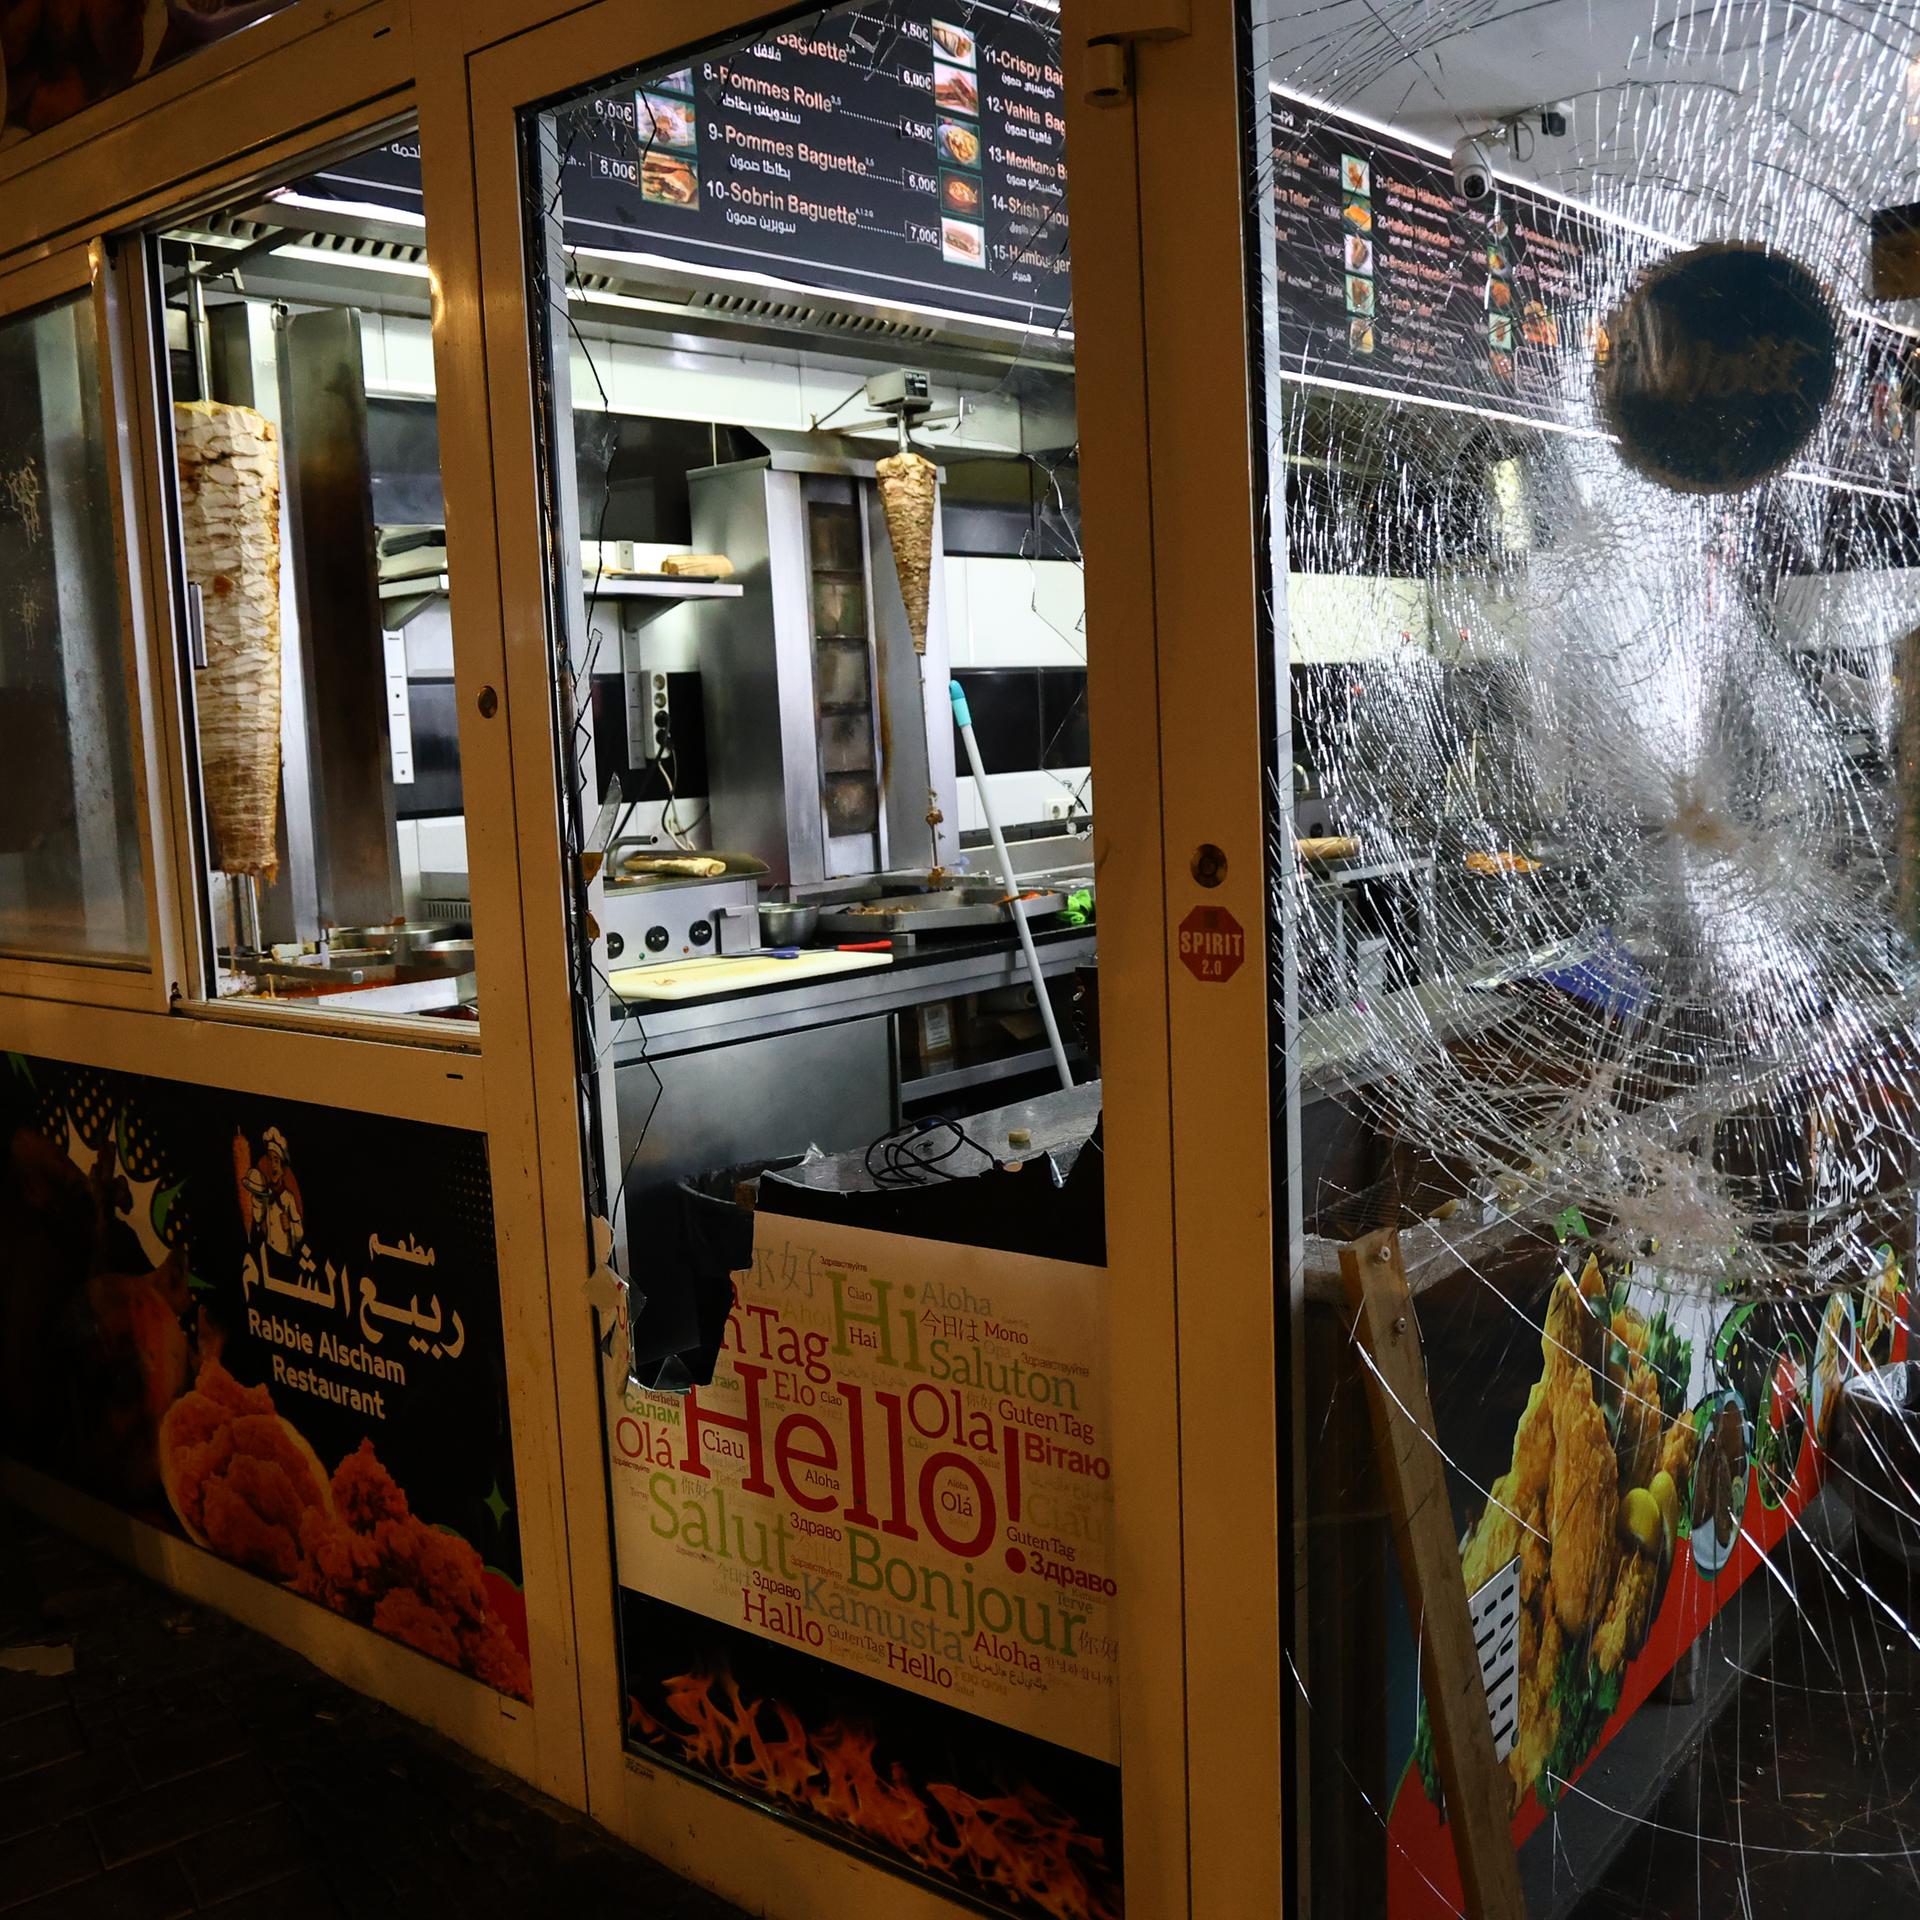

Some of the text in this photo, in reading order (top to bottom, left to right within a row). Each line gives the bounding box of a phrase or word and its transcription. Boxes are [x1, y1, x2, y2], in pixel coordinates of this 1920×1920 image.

[901, 22, 929, 42] 4,50€
[903, 70, 932, 91] 6,00€
[794, 86, 832, 113] Rolle
[905, 120, 933, 141] 4,50€
[600, 158, 636, 180] 8,00€
[798, 143, 867, 176] Baguette
[909, 175, 936, 193] 6,00€
[788, 194, 857, 226] Baguette
[911, 226, 938, 245] 7,00€
[1181, 931, 1242, 956] SPIRIT
[1202, 959, 1222, 976] 2.0
[369, 1232, 435, 1266] مطعم
[242, 1241, 465, 1359] ربيع الشام
[847, 1286, 872, 1302] Ciao
[920, 1281, 993, 1317] Aloha
[825, 1270, 927, 1374] Hi
[848, 1326, 878, 1349] Hai
[920, 1308, 980, 1342] 今日は
[984, 1320, 1029, 1345] Mono
[248, 1308, 406, 1386] Rabbie Alscham
[272, 1354, 386, 1420] Restaurant
[774, 1369, 815, 1406] Elo
[929, 1339, 1080, 1411] Saluton
[623, 1392, 680, 1426] Салам
[820, 1391, 843, 1406] Ciao
[908, 1383, 998, 1455] Ola
[616, 1416, 675, 1470] Olá
[702, 1428, 746, 1460] Ciau
[1024, 1431, 1111, 1481] Вітаю
[805, 1469, 841, 1491] Aloha
[941, 1490, 973, 1517] Olá
[649, 1472, 798, 1580] Salut
[790, 1512, 842, 1542] Здраво
[753, 1570, 801, 1600] Здраво
[1030, 1550, 1118, 1596] Здраво
[844, 1526, 1087, 1658] Bonjour
[741, 1587, 824, 1647] Hallo
[802, 1571, 966, 1664] Kamusta
[887, 1641, 953, 1689] Hello
[974, 1631, 1042, 1674] Aloha
